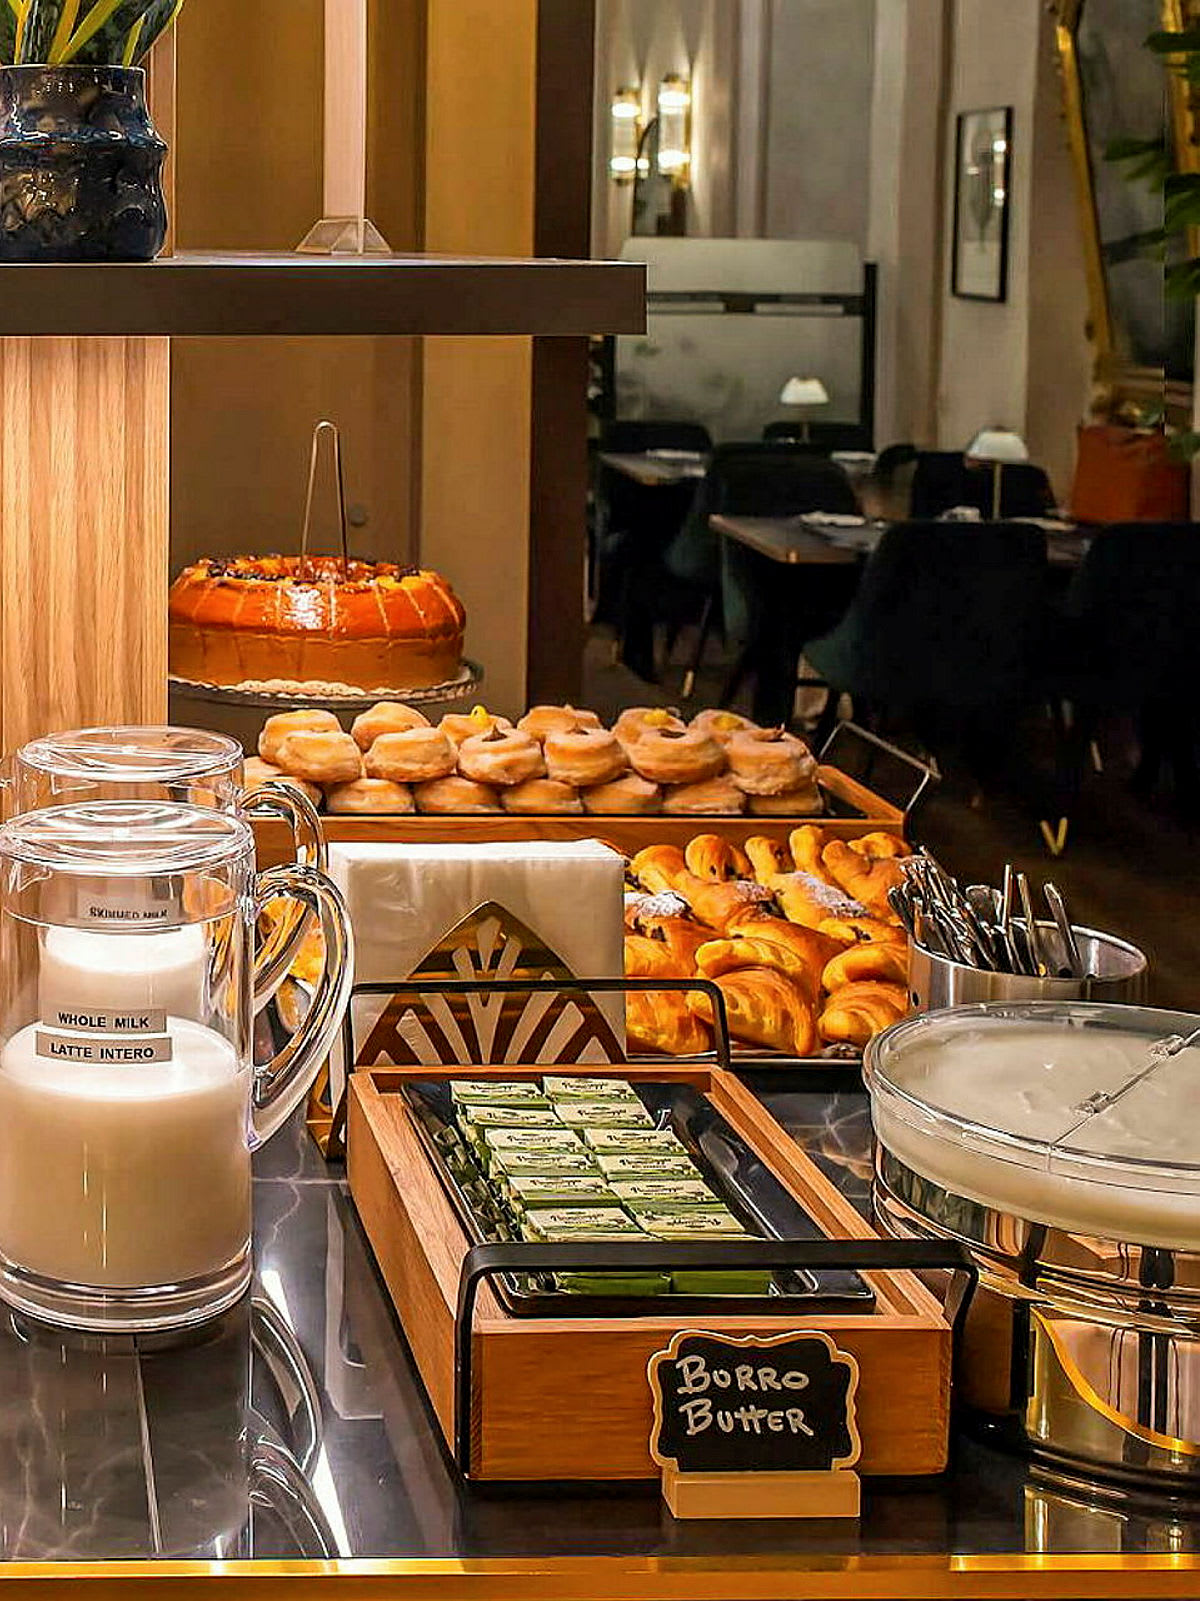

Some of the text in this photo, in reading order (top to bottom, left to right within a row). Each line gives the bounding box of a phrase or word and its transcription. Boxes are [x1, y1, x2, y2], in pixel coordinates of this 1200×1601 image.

[58, 1011, 150, 1029] WHOLE MILK
[50, 1042, 154, 1060] LATTE INTERO
[675, 1354, 810, 1395] BURRO
[678, 1398, 815, 1437] BUTTER
